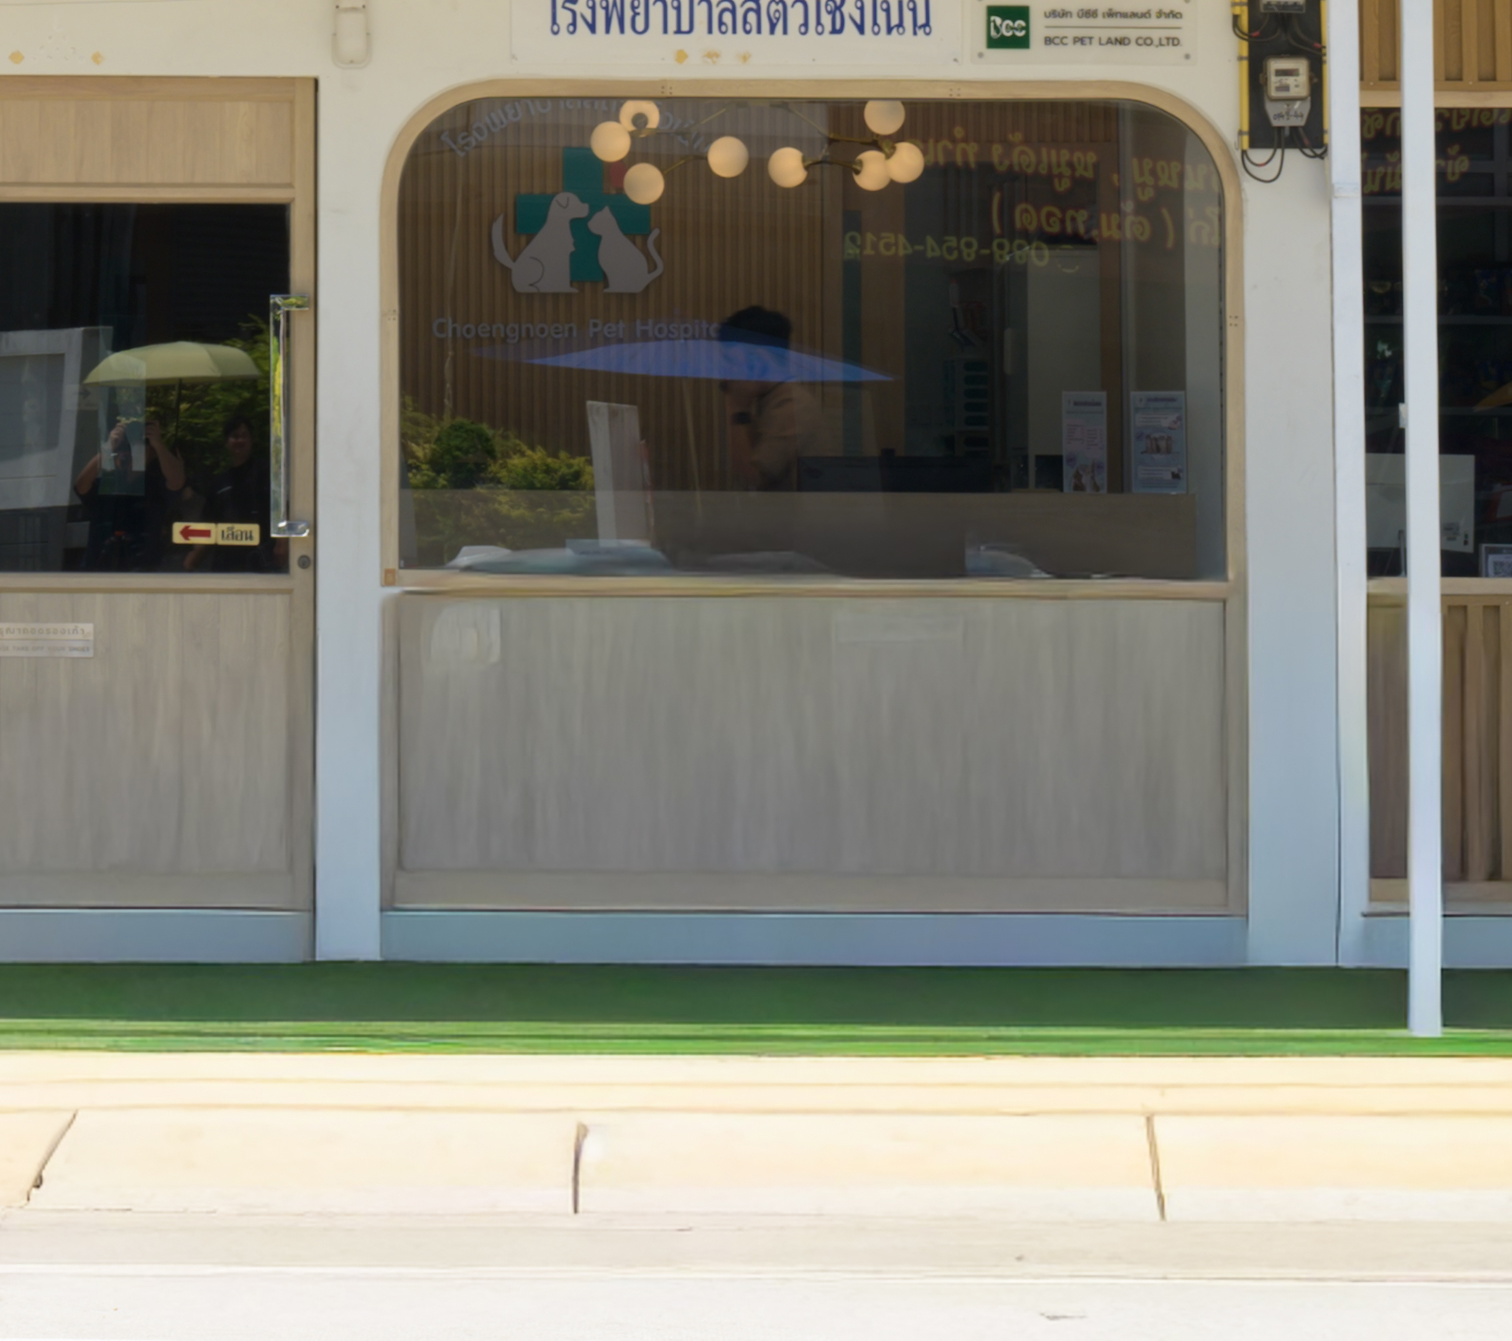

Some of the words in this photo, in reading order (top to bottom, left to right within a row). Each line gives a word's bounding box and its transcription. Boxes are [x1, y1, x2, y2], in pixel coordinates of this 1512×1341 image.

[1044, 37, 1068, 46] BCC
[1073, 37, 1094, 46] PET
[1099, 37, 1131, 47] LAND
[432, 317, 577, 343] Choengnoen
[588, 318, 625, 338] Pet
